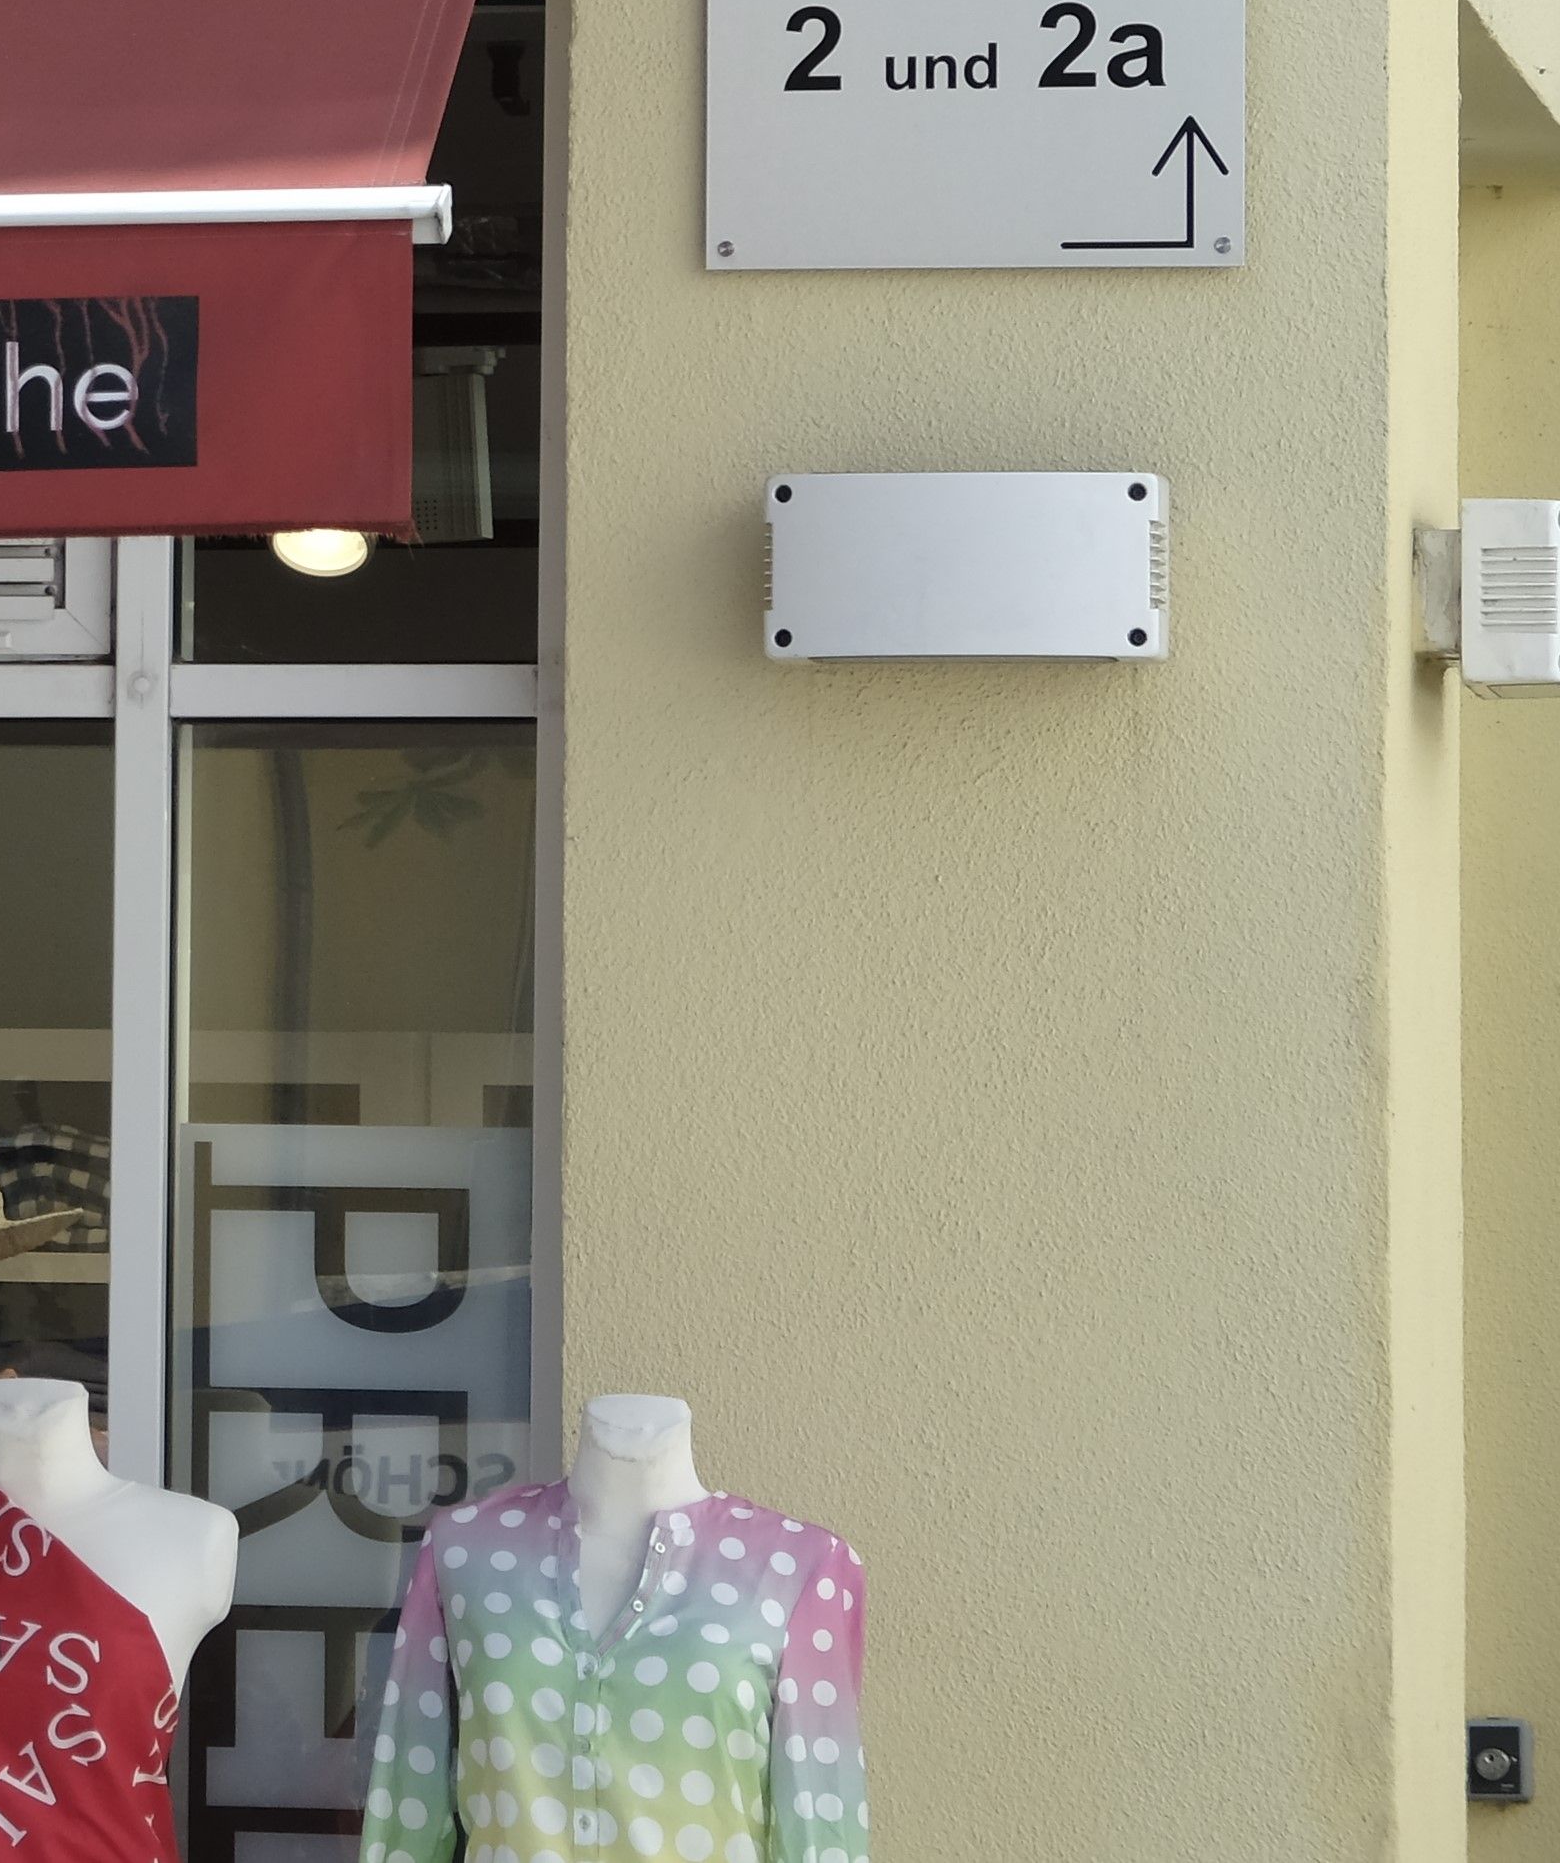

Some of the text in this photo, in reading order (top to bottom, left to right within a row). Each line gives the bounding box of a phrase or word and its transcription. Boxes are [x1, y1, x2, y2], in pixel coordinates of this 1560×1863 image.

[783, 1, 1167, 92] 2 und 2a
